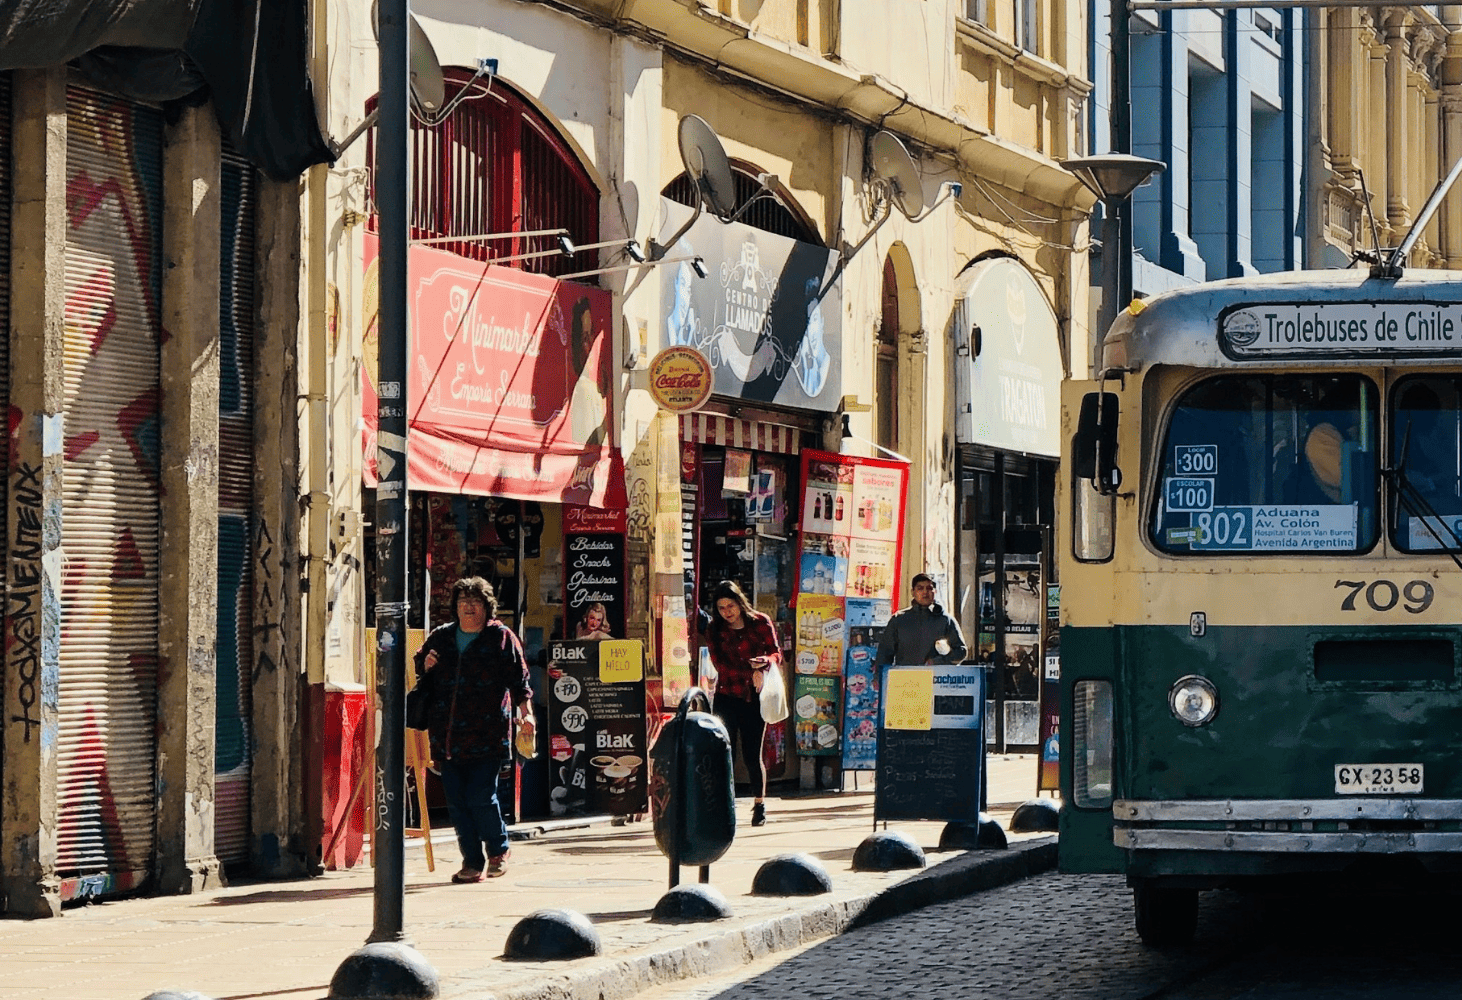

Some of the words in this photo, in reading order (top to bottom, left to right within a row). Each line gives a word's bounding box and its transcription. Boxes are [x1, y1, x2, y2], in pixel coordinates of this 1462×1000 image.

[725, 287, 758, 311] CENTRO
[762, 298, 773, 313] DE
[443, 285, 544, 375] Minimarket
[725, 303, 773, 337] LLAMADOS
[1264, 311, 1368, 343] Trolebuses
[1374, 311, 1398, 342] de
[1405, 310, 1454, 342] Chile
[451, 360, 493, 407] Emporio
[495, 369, 537, 410] Serrano
[655, 373, 703, 389] Coca-Cola
[1255, 507, 1320, 518] Aduana
[1198, 511, 1248, 545] 802
[1255, 518, 1275, 528] Av.
[1281, 518, 1320, 528] Colón
[569, 536, 615, 551] Bebidas
[1254, 529, 1286, 538] Hospital
[1288, 529, 1311, 537] Carlos
[1313, 529, 1328, 537] Van
[1254, 538, 1298, 548] Avenida
[1301, 538, 1354, 549] Argentina
[573, 553, 612, 568] Snacks
[566, 571, 618, 591] Golosinas
[569, 588, 615, 608] Galletas
[1334, 578, 1435, 614] 709
[610, 648, 628, 659] HAY
